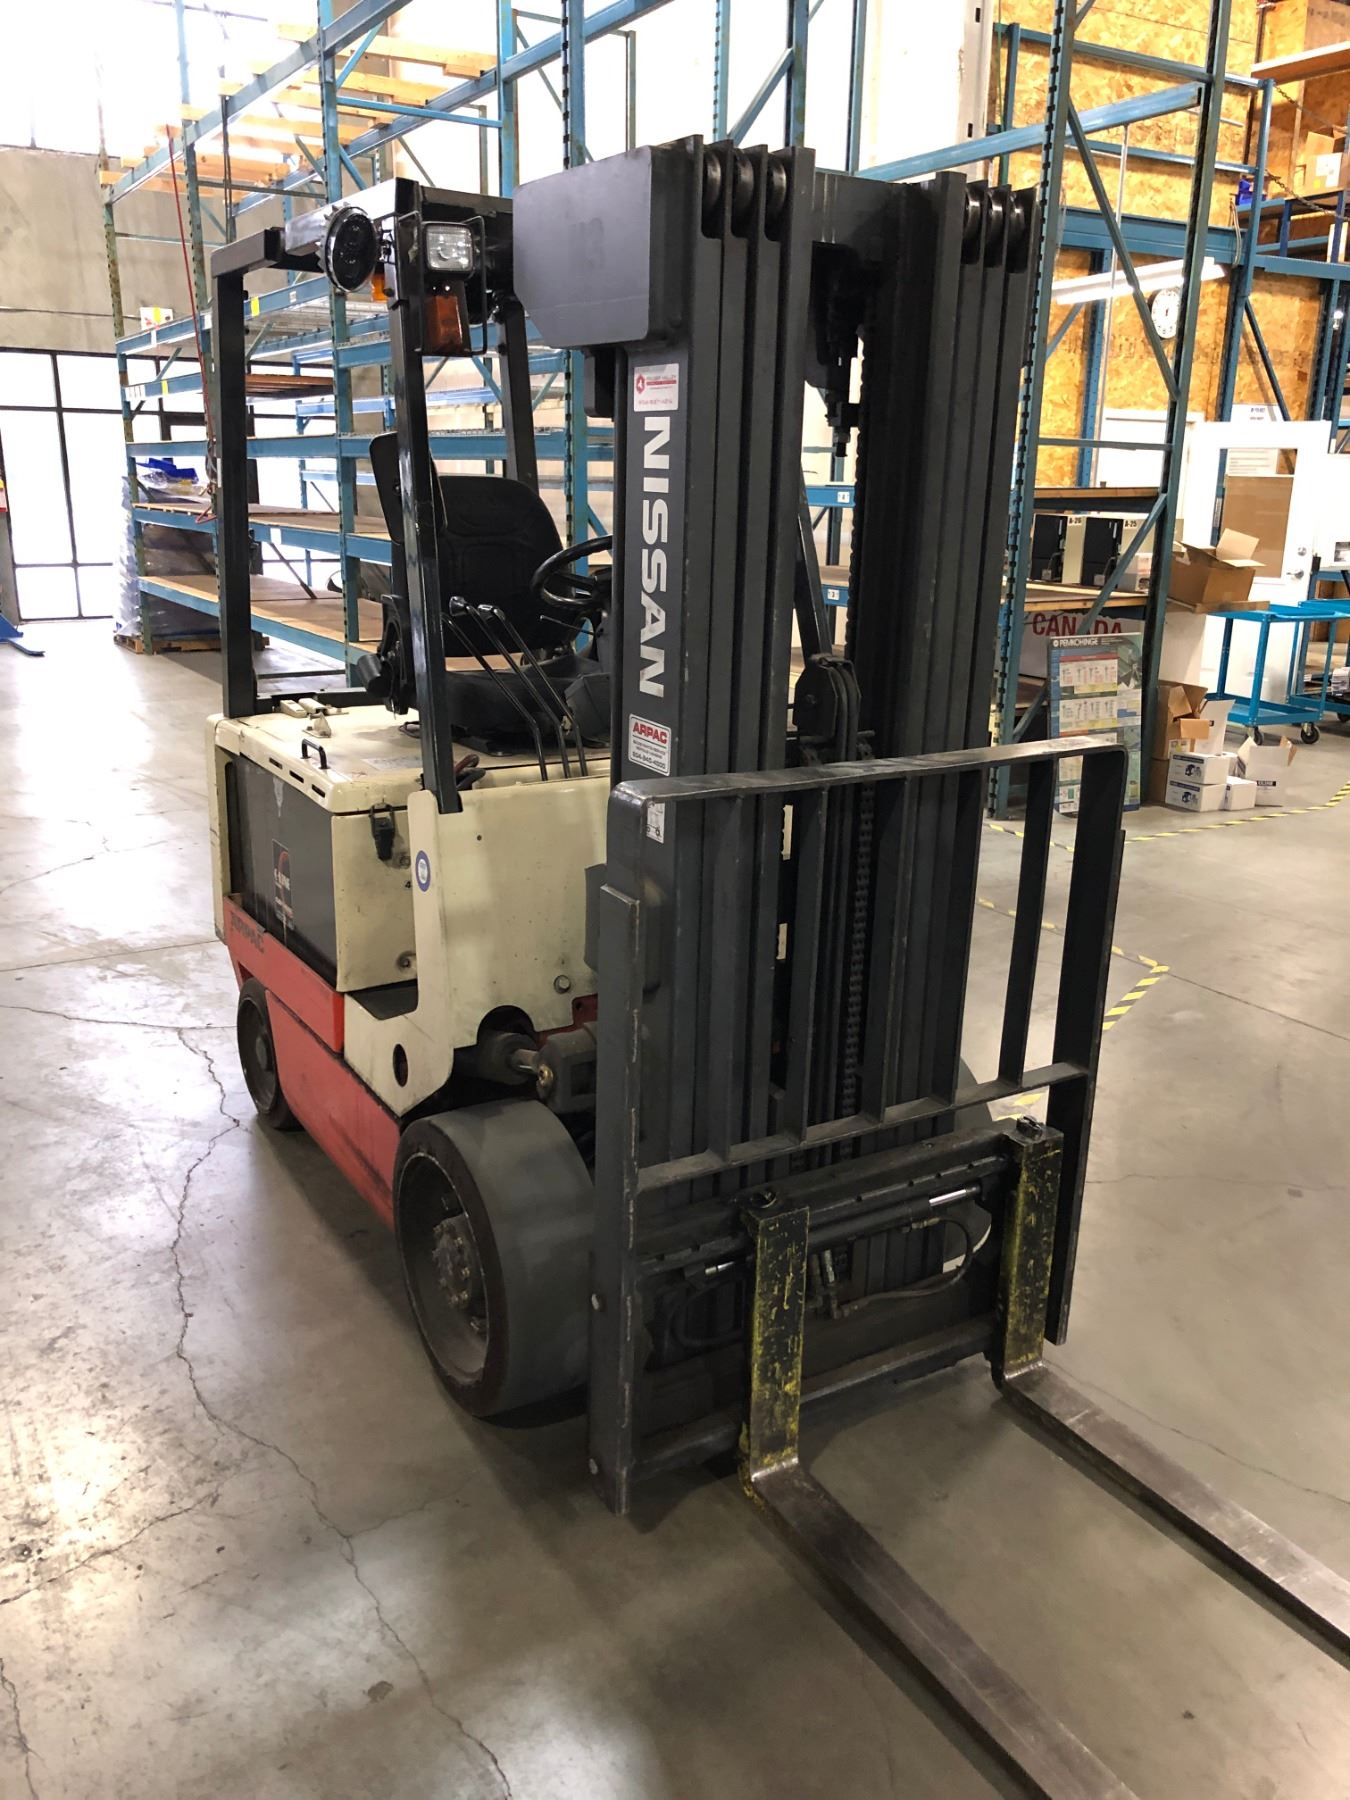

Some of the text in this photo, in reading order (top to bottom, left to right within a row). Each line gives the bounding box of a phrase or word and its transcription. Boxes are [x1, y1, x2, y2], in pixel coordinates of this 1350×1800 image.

[639, 416, 670, 698] NISSAN
[1032, 612, 1122, 636] CANDA
[633, 721, 667, 744] ARPAC
